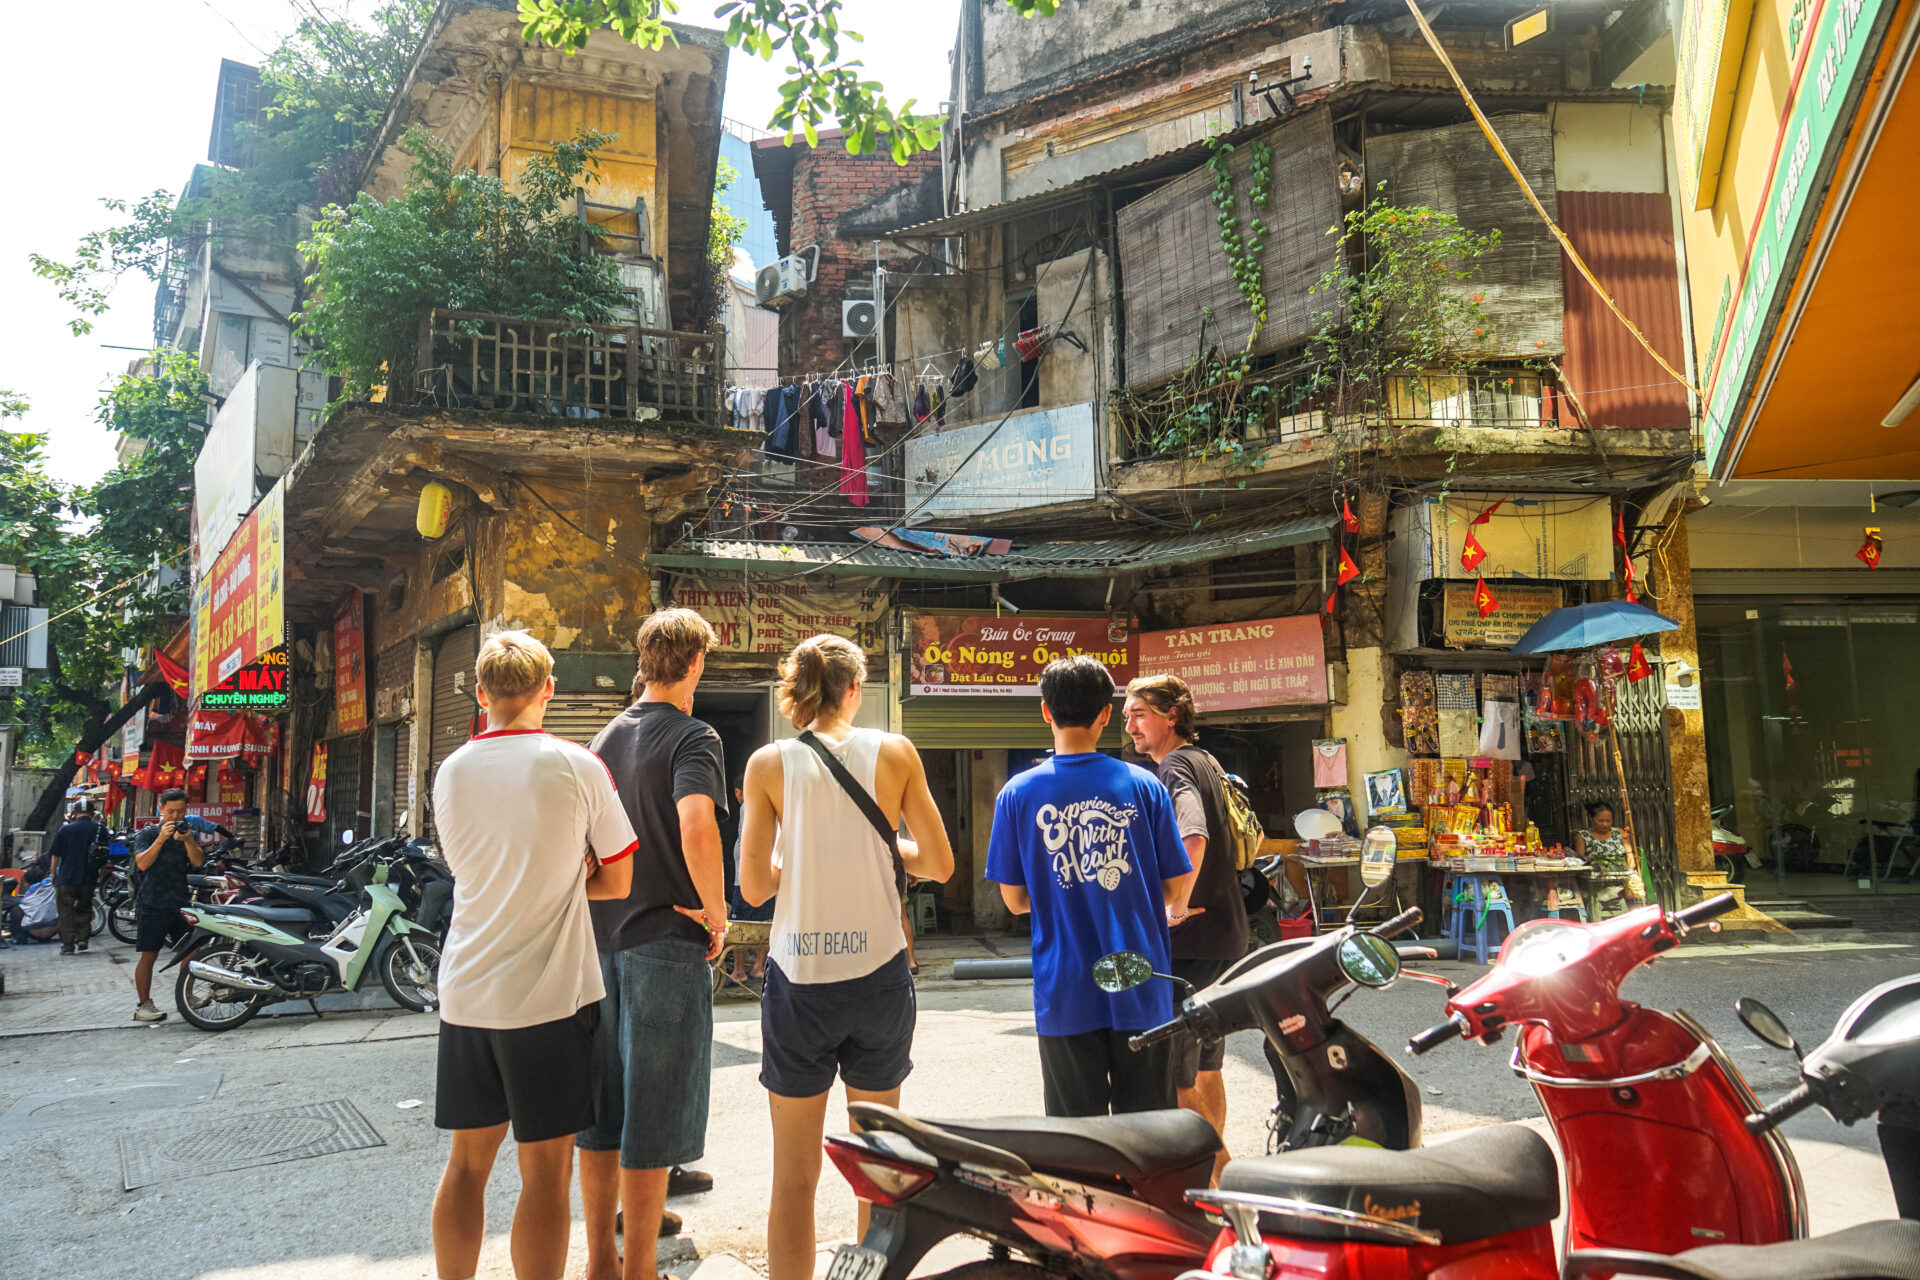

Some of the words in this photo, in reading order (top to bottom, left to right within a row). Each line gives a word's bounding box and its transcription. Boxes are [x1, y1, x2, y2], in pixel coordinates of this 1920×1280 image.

[976, 434, 1072, 475] MÓNG
[679, 589, 711, 611] THỊT
[714, 585, 747, 607] XIÊN
[860, 601, 874, 612] 7K
[757, 612, 784, 625] PATÊ
[797, 615, 820, 627] THỊT
[825, 613, 852, 626] XIÊN
[757, 627, 784, 639] PATÊ
[981, 626, 1008, 642] Bún
[1013, 621, 1032, 642] Ốc
[1165, 630, 1203, 648] TÂN
[1208, 625, 1275, 643] TRANG
[924, 641, 952, 664] Ốc
[959, 646, 1015, 668] Nóng
[1033, 642, 1060, 664] Ốc
[1066, 647, 1128, 668] Nuội
[1241, 655, 1257, 672] HỎI
[1278, 656, 1294, 669] XIN
[239, 665, 286, 690] MÁY
[951, 673, 970, 685] Đặt
[997, 673, 1018, 684] Cua
[1233, 678, 1248, 696] ĐỘI
[1271, 674, 1283, 689] BÊ
[1285, 672, 1308, 688] TRÁP
[205, 691, 247, 704] CHUYÊN
[249, 691, 286, 705] NGHIỆP
[194, 721, 217, 731] MÁY
[1036, 796, 1131, 852] Experiences
[1069, 822, 1118, 854] With
[1053, 828, 1127, 882] Heart
[824, 930, 867, 955] BEACH
